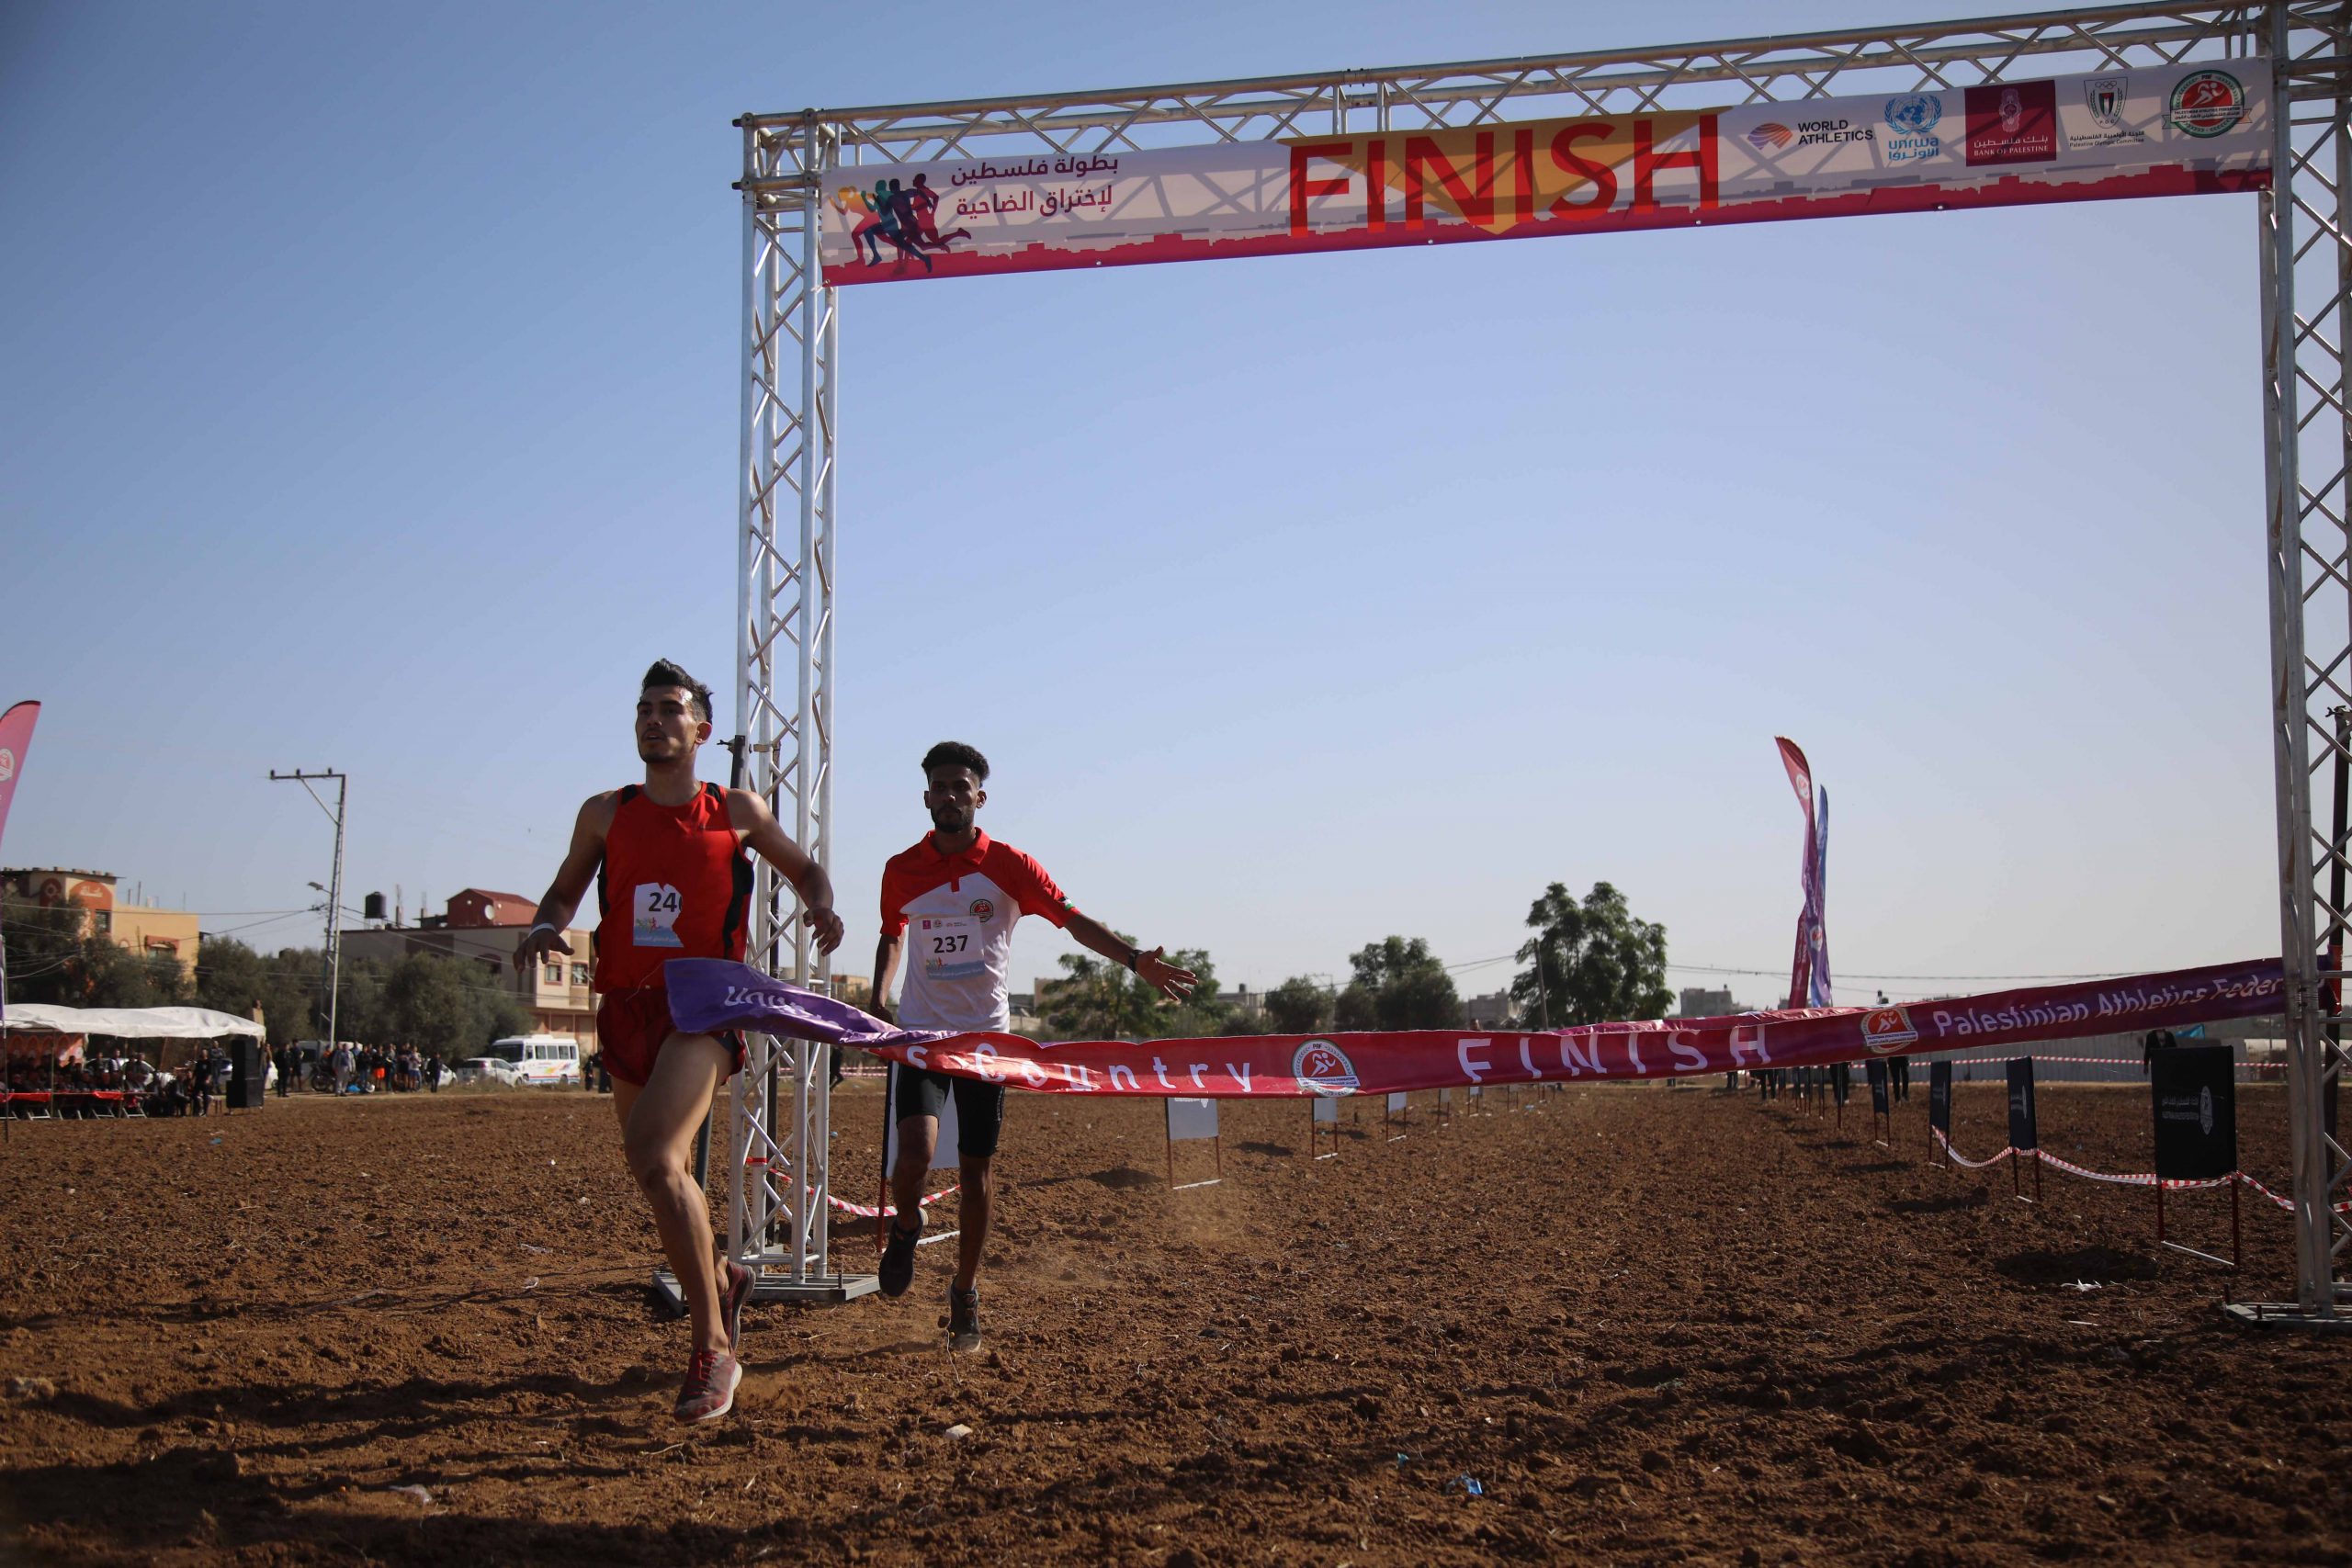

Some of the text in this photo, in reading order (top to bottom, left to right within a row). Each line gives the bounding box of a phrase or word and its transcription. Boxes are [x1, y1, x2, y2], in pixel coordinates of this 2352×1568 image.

[1798, 119, 1849, 132] WORLD
[1798, 130, 1873, 145] ATHLETICS
[1888, 137, 1939, 150] unrwa
[1973, 145, 2048, 156] BANK OF PALESTINE
[951, 154, 1118, 186] بطولة فلسطين
[1289, 114, 1718, 238] FINISH
[956, 185, 1113, 220] لإختراق الضاحية
[648, 891, 683, 913] 24
[933, 934, 968, 953] 237
[1932, 1000, 2089, 1037] Palestinian
[2095, 985, 2208, 1018] Athletics
[1457, 1022, 1772, 1084] FINISH
[975, 1043, 1251, 1093] Country
